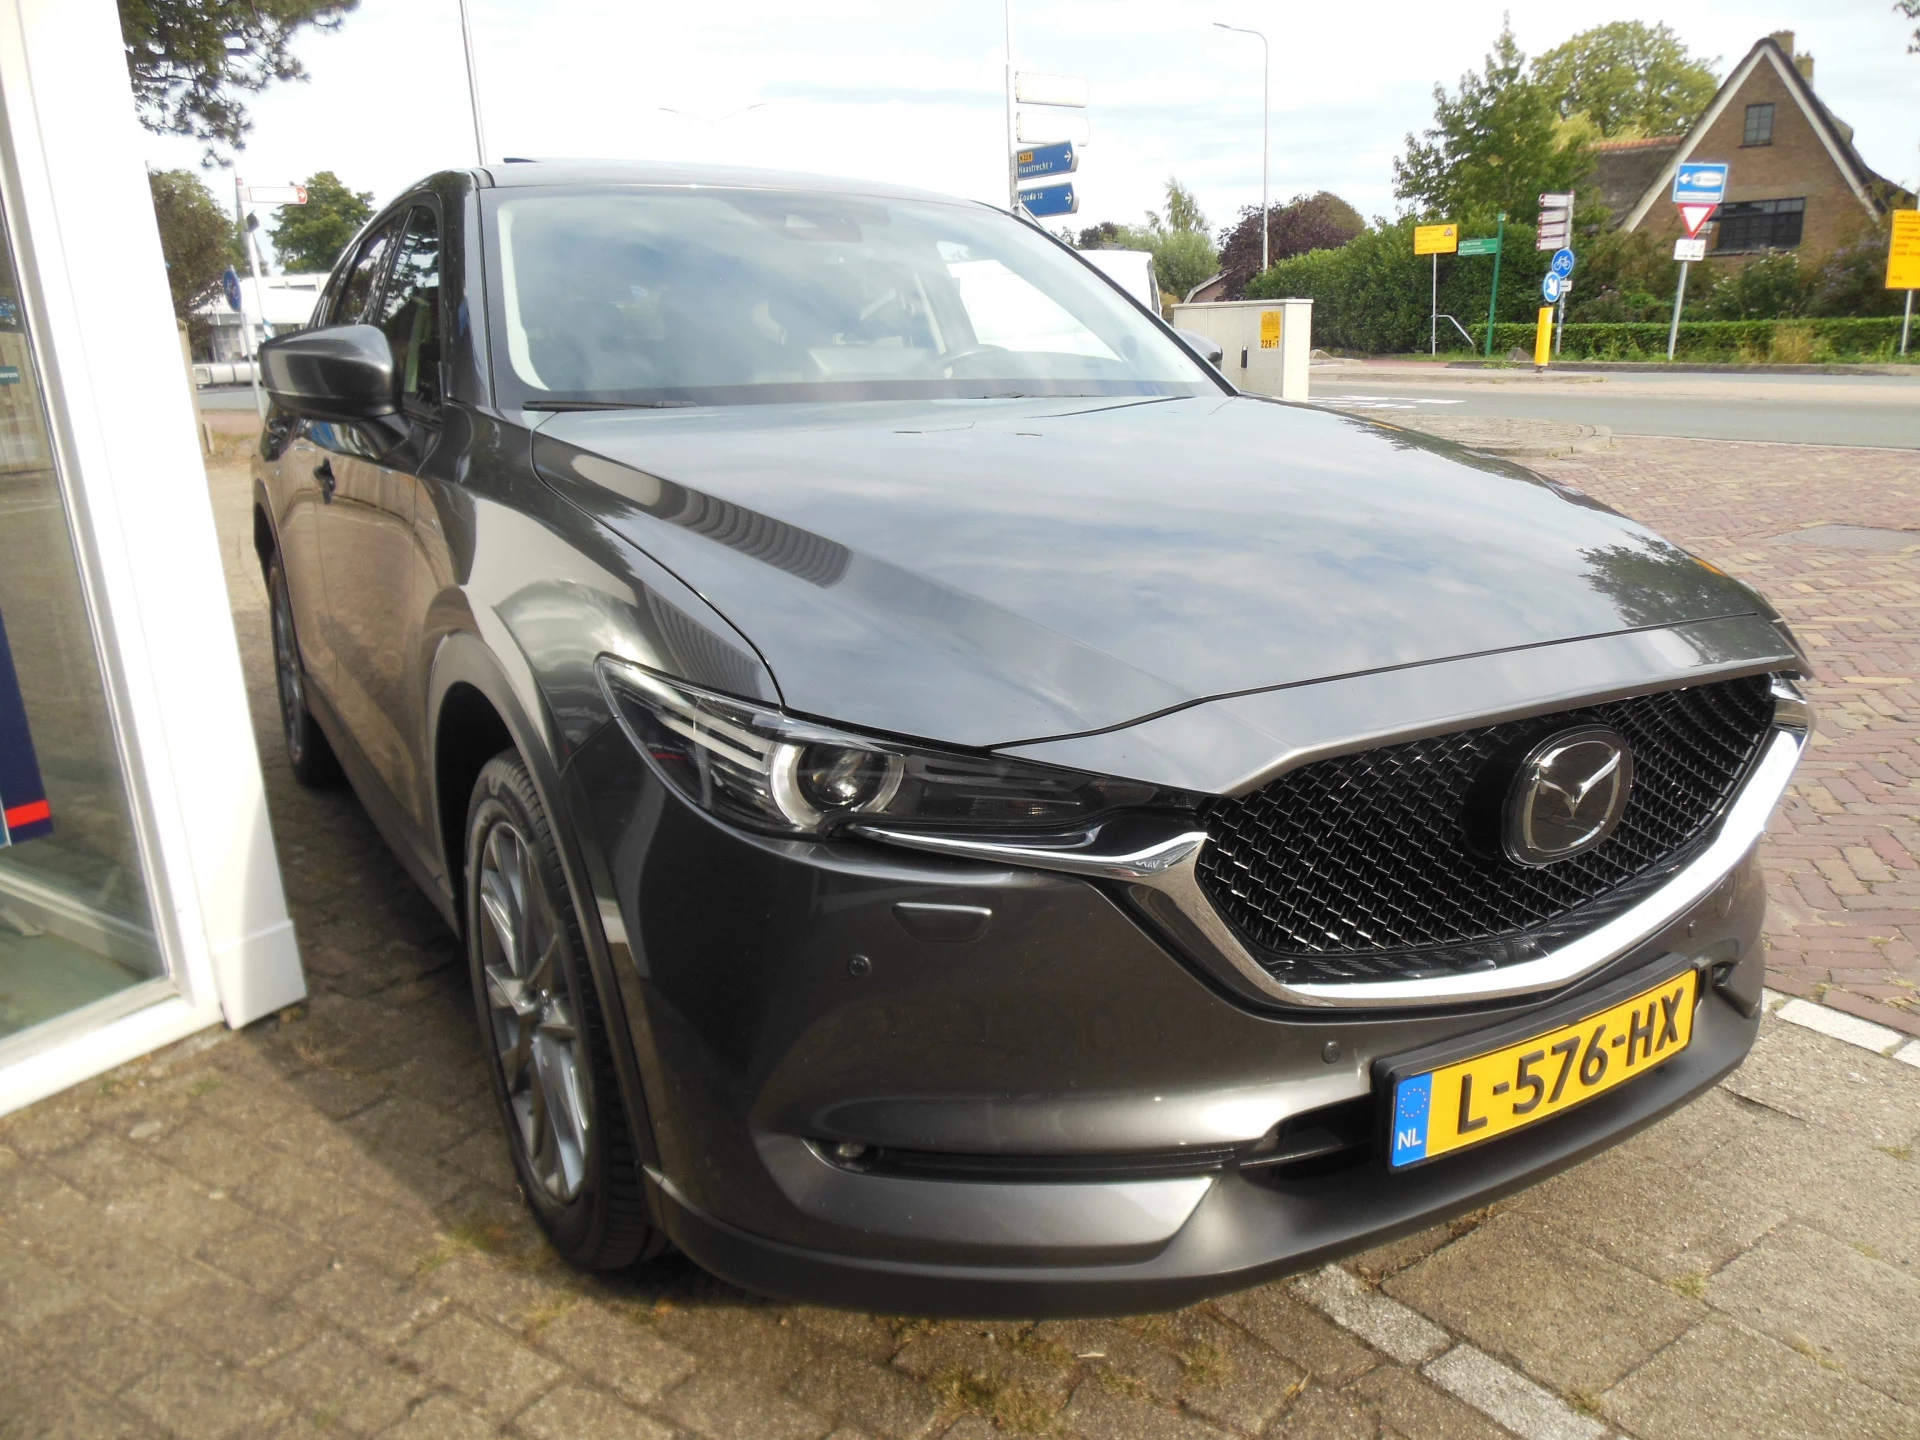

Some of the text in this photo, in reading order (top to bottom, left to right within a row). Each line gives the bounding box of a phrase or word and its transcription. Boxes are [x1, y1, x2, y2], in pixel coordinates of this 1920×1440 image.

[1018, 162, 1048, 174] Haastrecht
[1020, 192, 1036, 202] Gouda
[1457, 987, 1684, 1135] L-576-HX
[1398, 1129, 1421, 1150] NL
